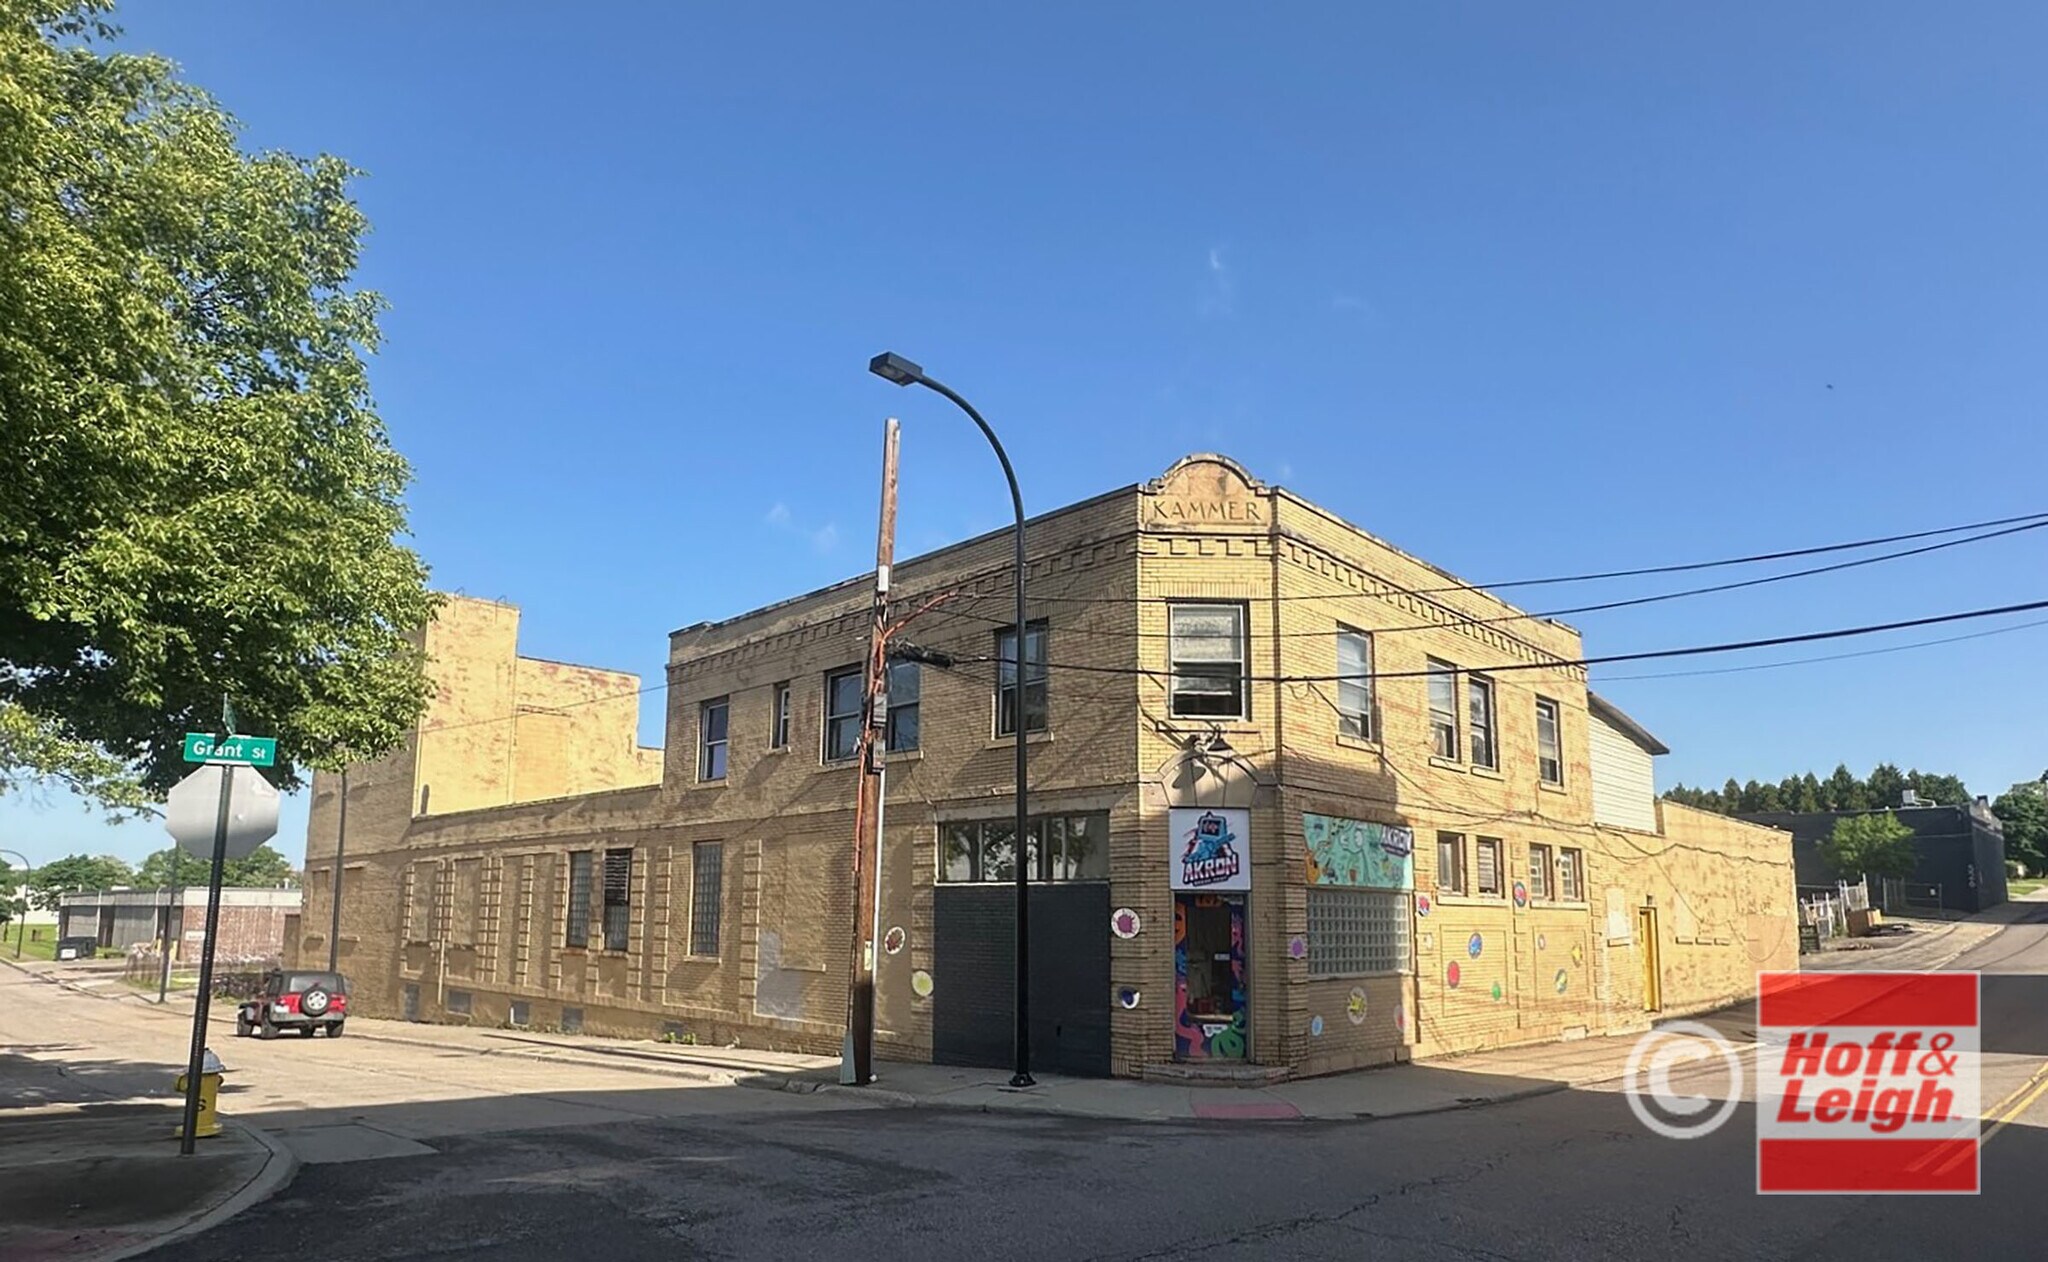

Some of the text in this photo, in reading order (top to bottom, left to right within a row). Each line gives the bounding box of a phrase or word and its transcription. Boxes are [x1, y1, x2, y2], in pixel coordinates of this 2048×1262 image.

[1153, 500, 1261, 520] KAMMER
[193, 740, 243, 757] Grant
[1184, 854, 1237, 883] AKRON
